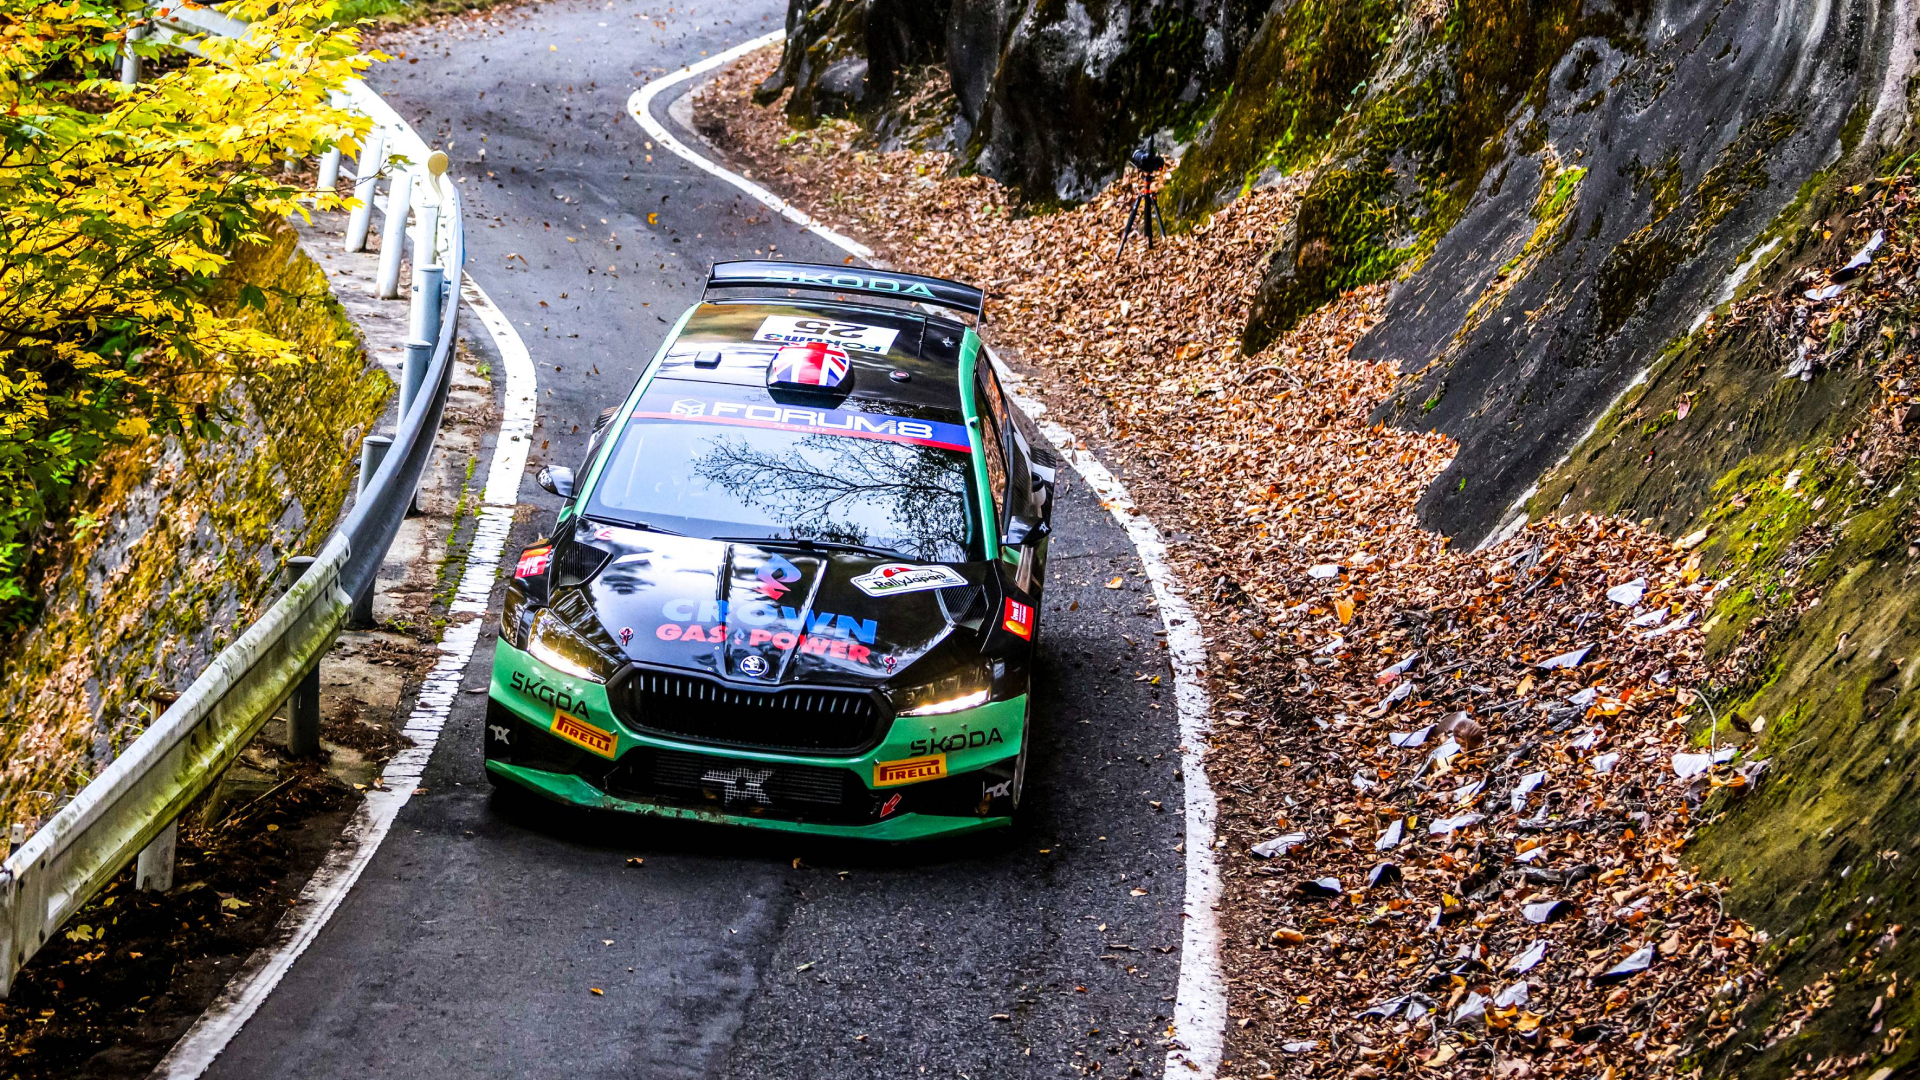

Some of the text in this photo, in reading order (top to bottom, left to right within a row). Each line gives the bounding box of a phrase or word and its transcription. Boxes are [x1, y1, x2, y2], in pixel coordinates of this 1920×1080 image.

[793, 320, 868, 339] 25
[711, 401, 933, 439] FORUM8
[662, 599, 877, 644] CROWN
[656, 624, 870, 663] GAS POWER
[556, 715, 611, 752] PIRELLI
[880, 759, 940, 781] PIRELLI
